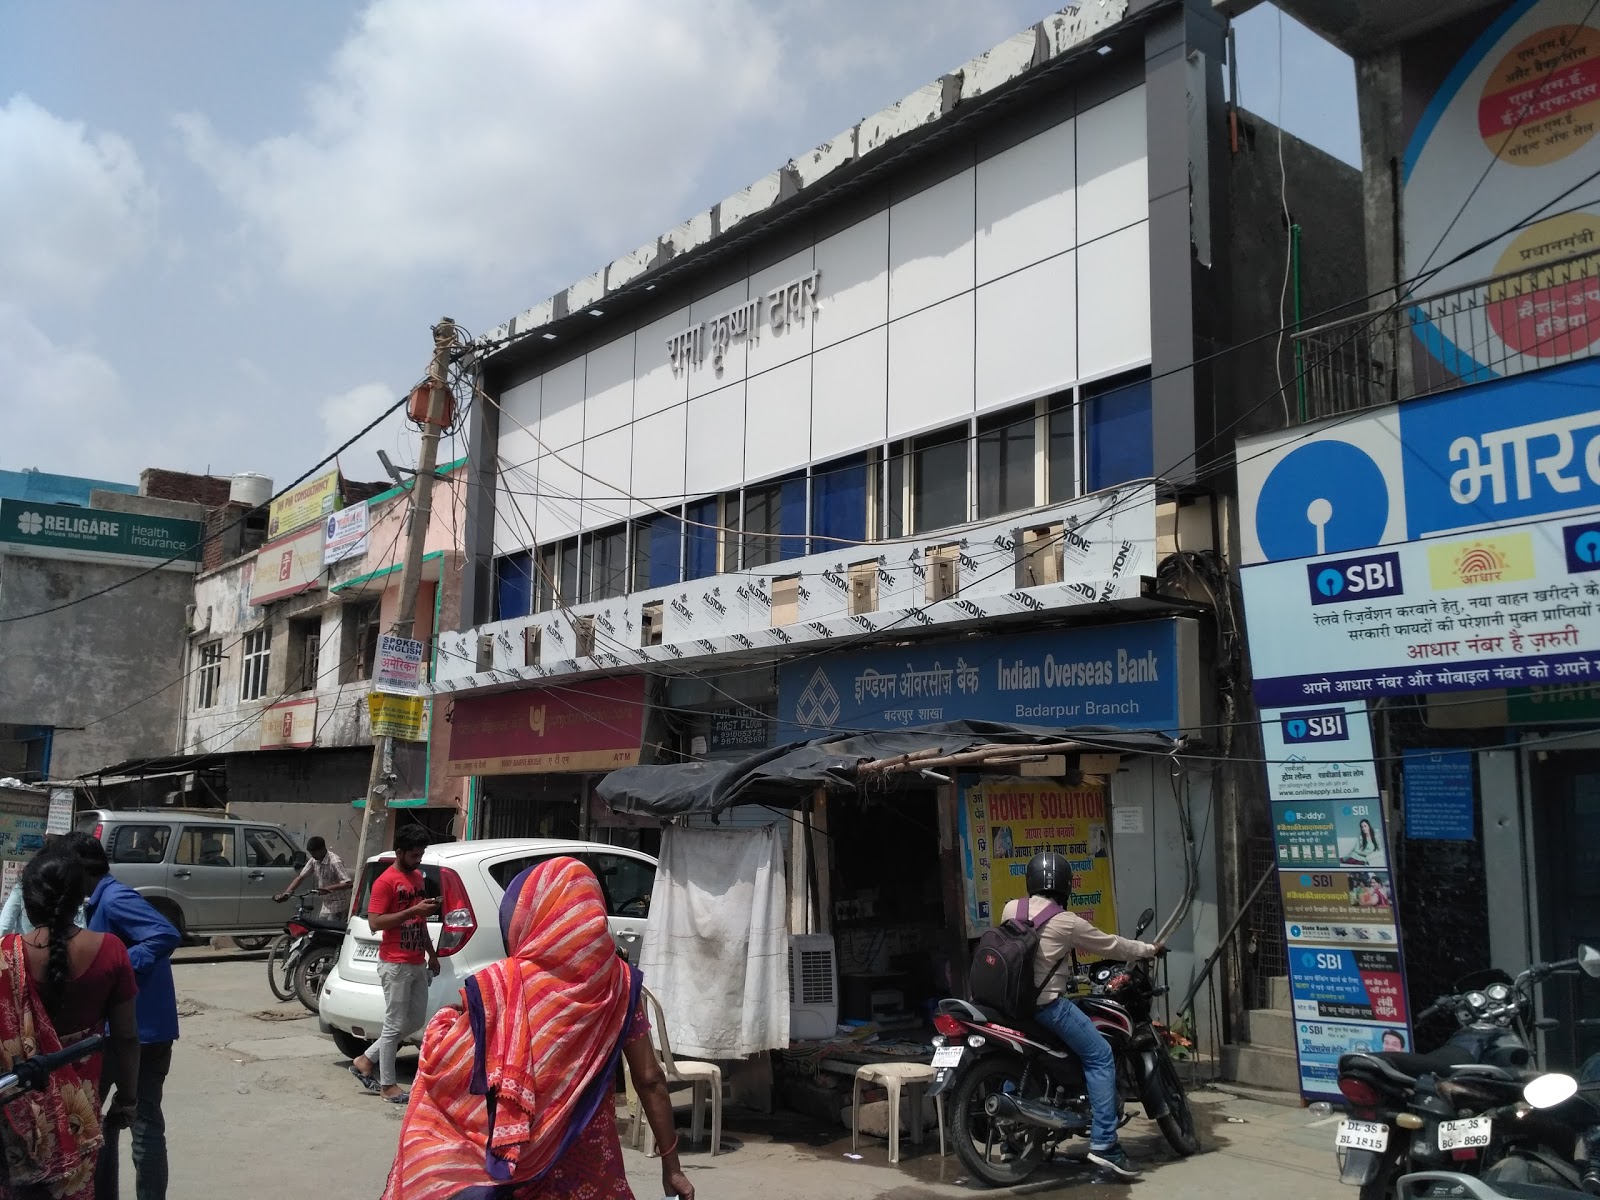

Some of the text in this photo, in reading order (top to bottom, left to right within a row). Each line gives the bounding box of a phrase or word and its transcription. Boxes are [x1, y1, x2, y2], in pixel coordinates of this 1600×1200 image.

[1519, 227, 1595, 261] प्रधानमंत्री
[709, 297, 762, 371] कृष्णा
[767, 269, 821, 328] टावर
[44, 514, 169, 538] RELIGARE Health
[83, 533, 97, 541] bind
[131, 535, 187, 550] Insurance
[1346, 561, 1395, 593] SBI
[1460, 571, 1503, 585] आधार
[703, 592, 727, 615] ALSTONE
[749, 583, 772, 607] ALSTONE
[1313, 580, 1599, 627] रेलवे रिज़र्वेशन करवाने हेतु, नया वाहन खरीदने के
[671, 598, 694, 621] ALSTONE
[597, 614, 616, 635] ALSTONE
[1348, 623, 1390, 641] सरकारी
[1394, 618, 1433, 637] फायदों
[1438, 616, 1455, 632] की
[1459, 611, 1504, 629] परेशानी
[1509, 611, 1538, 629] मुक्त
[1542, 601, 1592, 621] प्राप्तियों
[547, 624, 564, 644] ALSTONE
[382, 643, 422, 656] ENGLISH
[383, 637, 423, 649] SPOKEN
[1407, 640, 1460, 659] आधार
[1465, 634, 1505, 653] नंबर
[1509, 629, 1524, 653] है
[381, 656, 419, 673] अमेरिकन
[998, 648, 1158, 692] Indian Overseas Bank
[854, 656, 979, 705] इण्डियन ओवरसीज़ बैंक
[1303, 678, 1331, 694] अपने
[1335, 679, 1373, 692] आधार
[1375, 673, 1404, 689] नंबर
[1407, 669, 1434, 687] और
[1436, 668, 1490, 686] मोबाइल
[1493, 664, 1524, 680] नंबर
[1528, 660, 1550, 678] को
[1554, 656, 1590, 676] अपने
[884, 706, 943, 725] बदरपुर शाखा
[1015, 700, 1139, 718] Badarpur Branch
[716, 720, 738, 731] FIRST
[1308, 715, 1343, 737] SBI
[613, 753, 631, 761] ATM
[1281, 773, 1293, 782] होम
[1279, 787, 1360, 796] www.onlineapply.sbi.co.in
[988, 792, 1034, 821] HONEY
[1041, 791, 1104, 820] SOLUTION
[1352, 805, 1369, 816] SBI
[1312, 874, 1333, 888] SBI
[1316, 953, 1342, 970] SBI
[1375, 1005, 1398, 1017] लाइन
[1309, 1025, 1323, 1035] SBI
[1347, 1121, 1378, 1134] DL 3S
[1446, 1122, 1458, 1132] DL
[1467, 1120, 1479, 1129] 3S
[1340, 1135, 1383, 1148] BL 1815
[1442, 1139, 1453, 1148] BG
[1464, 1136, 1488, 1145] 8969
